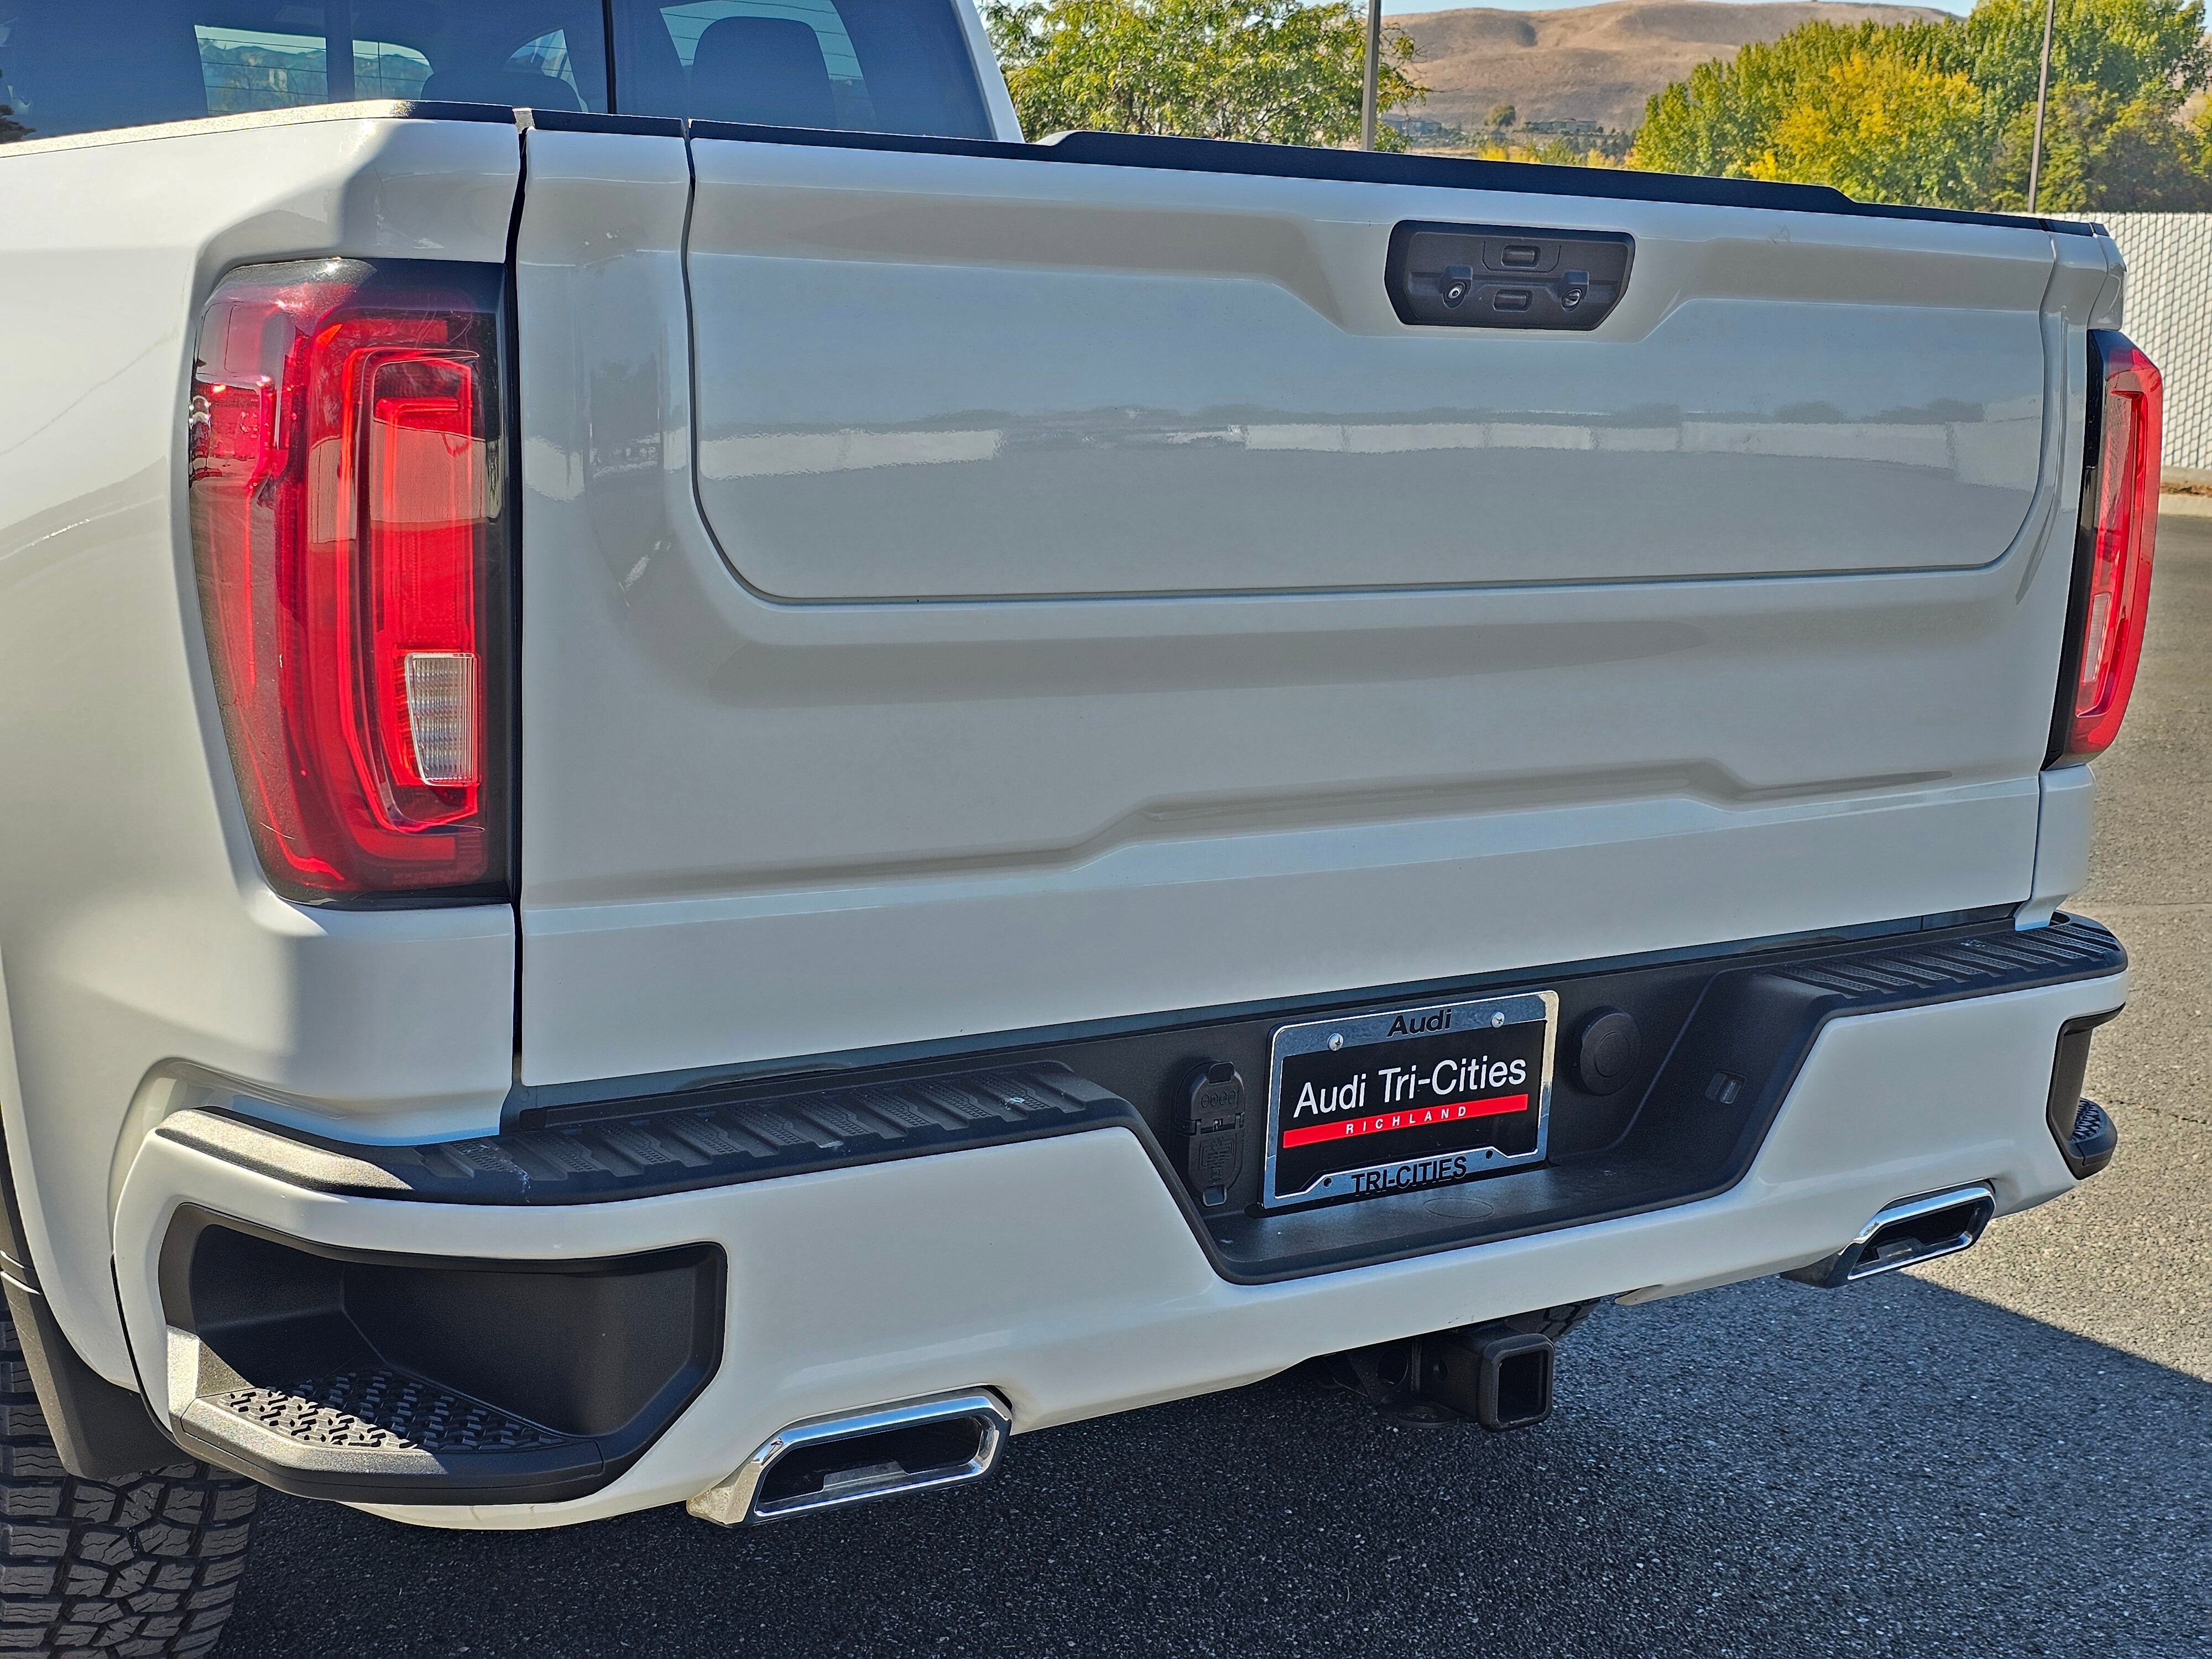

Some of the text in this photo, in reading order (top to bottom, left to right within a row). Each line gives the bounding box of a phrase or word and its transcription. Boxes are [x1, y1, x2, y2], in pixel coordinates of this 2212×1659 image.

[1386, 1009, 1452, 1037] Audi
[1293, 1055, 1526, 1118] Audi Tri-Cities
[1345, 1105, 1467, 1135] RICHLAND
[1351, 1156, 1467, 1195] TRI-CITIES
